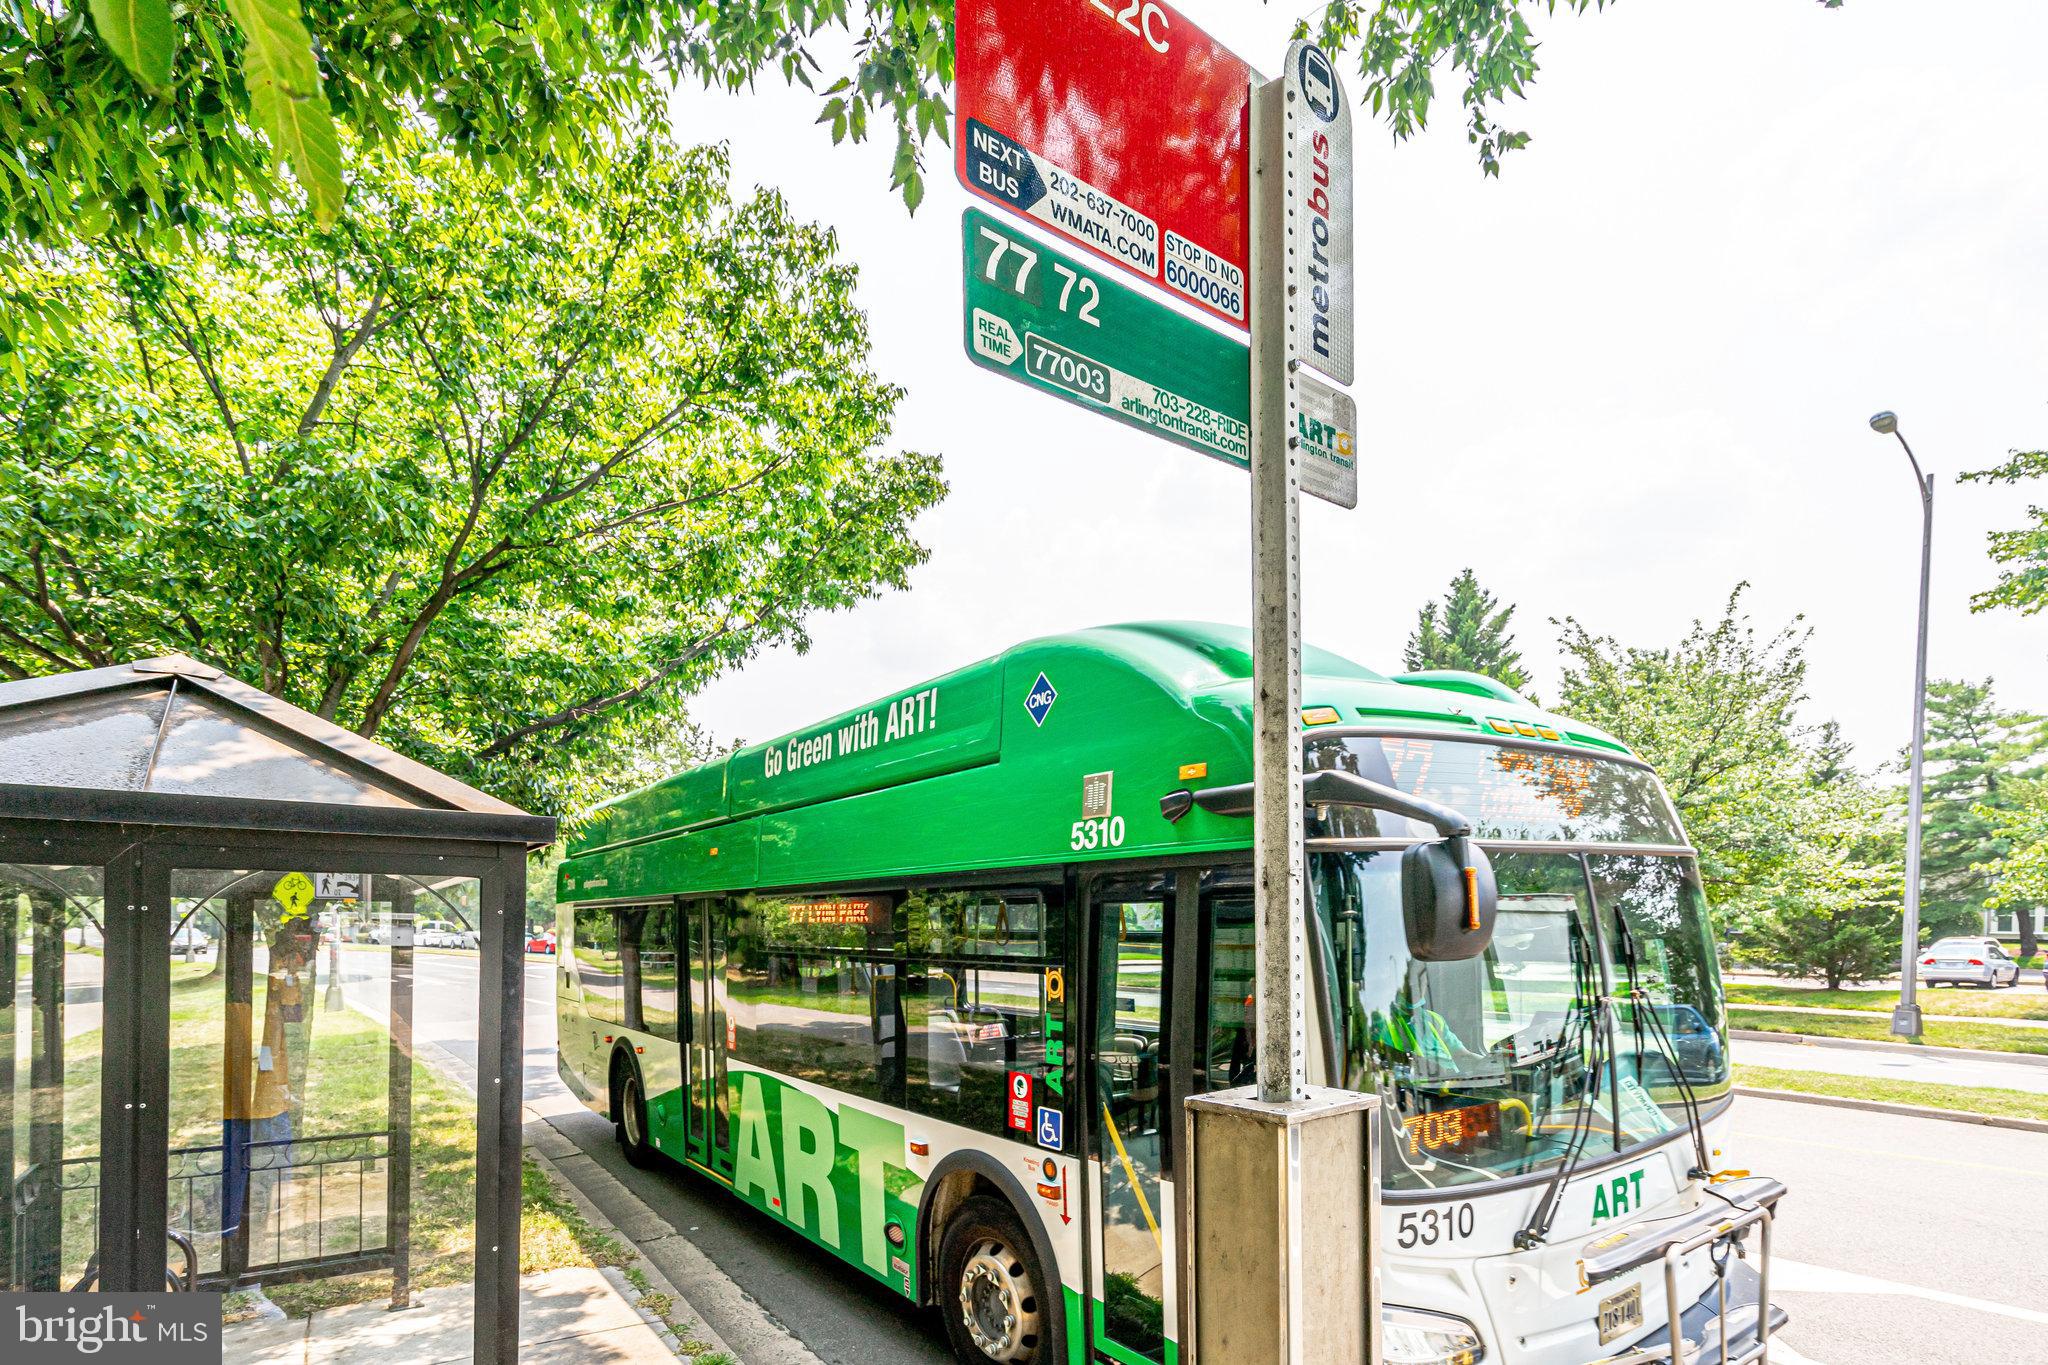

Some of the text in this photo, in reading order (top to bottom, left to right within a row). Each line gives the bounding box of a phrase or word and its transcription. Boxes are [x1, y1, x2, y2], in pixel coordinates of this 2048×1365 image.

[1090, 0, 1170, 53] 2C
[973, 123, 1024, 171] NEXT
[979, 161, 1020, 199] BUS
[1050, 171, 1155, 242] 202-637-7000
[1050, 200, 1156, 270] WMATA.COM
[1166, 233, 1243, 288] STOP ID NO.
[1308, 130, 1331, 358] metrobus
[980, 226, 1101, 328] 77 72
[1166, 260, 1240, 314] 6000066
[978, 317, 1012, 344] REAL
[980, 334, 1011, 358] TIME
[1033, 344, 1105, 395] 77003
[1121, 395, 1247, 457] arlingtontransit.com
[1152, 387, 1247, 441] 703-228-RIDE
[1299, 412, 1336, 450] ART
[1330, 451, 1354, 470] transit
[1028, 688, 1053, 709] CNG
[764, 687, 939, 779] Go Green with ART!
[1070, 815, 1126, 851] 5310
[1045, 1012, 1064, 1098] ART
[1403, 1108, 1463, 1155] 703
[734, 1072, 906, 1278] ART
[1591, 1168, 1645, 1228] ART
[1396, 1202, 1475, 1250] 5310
